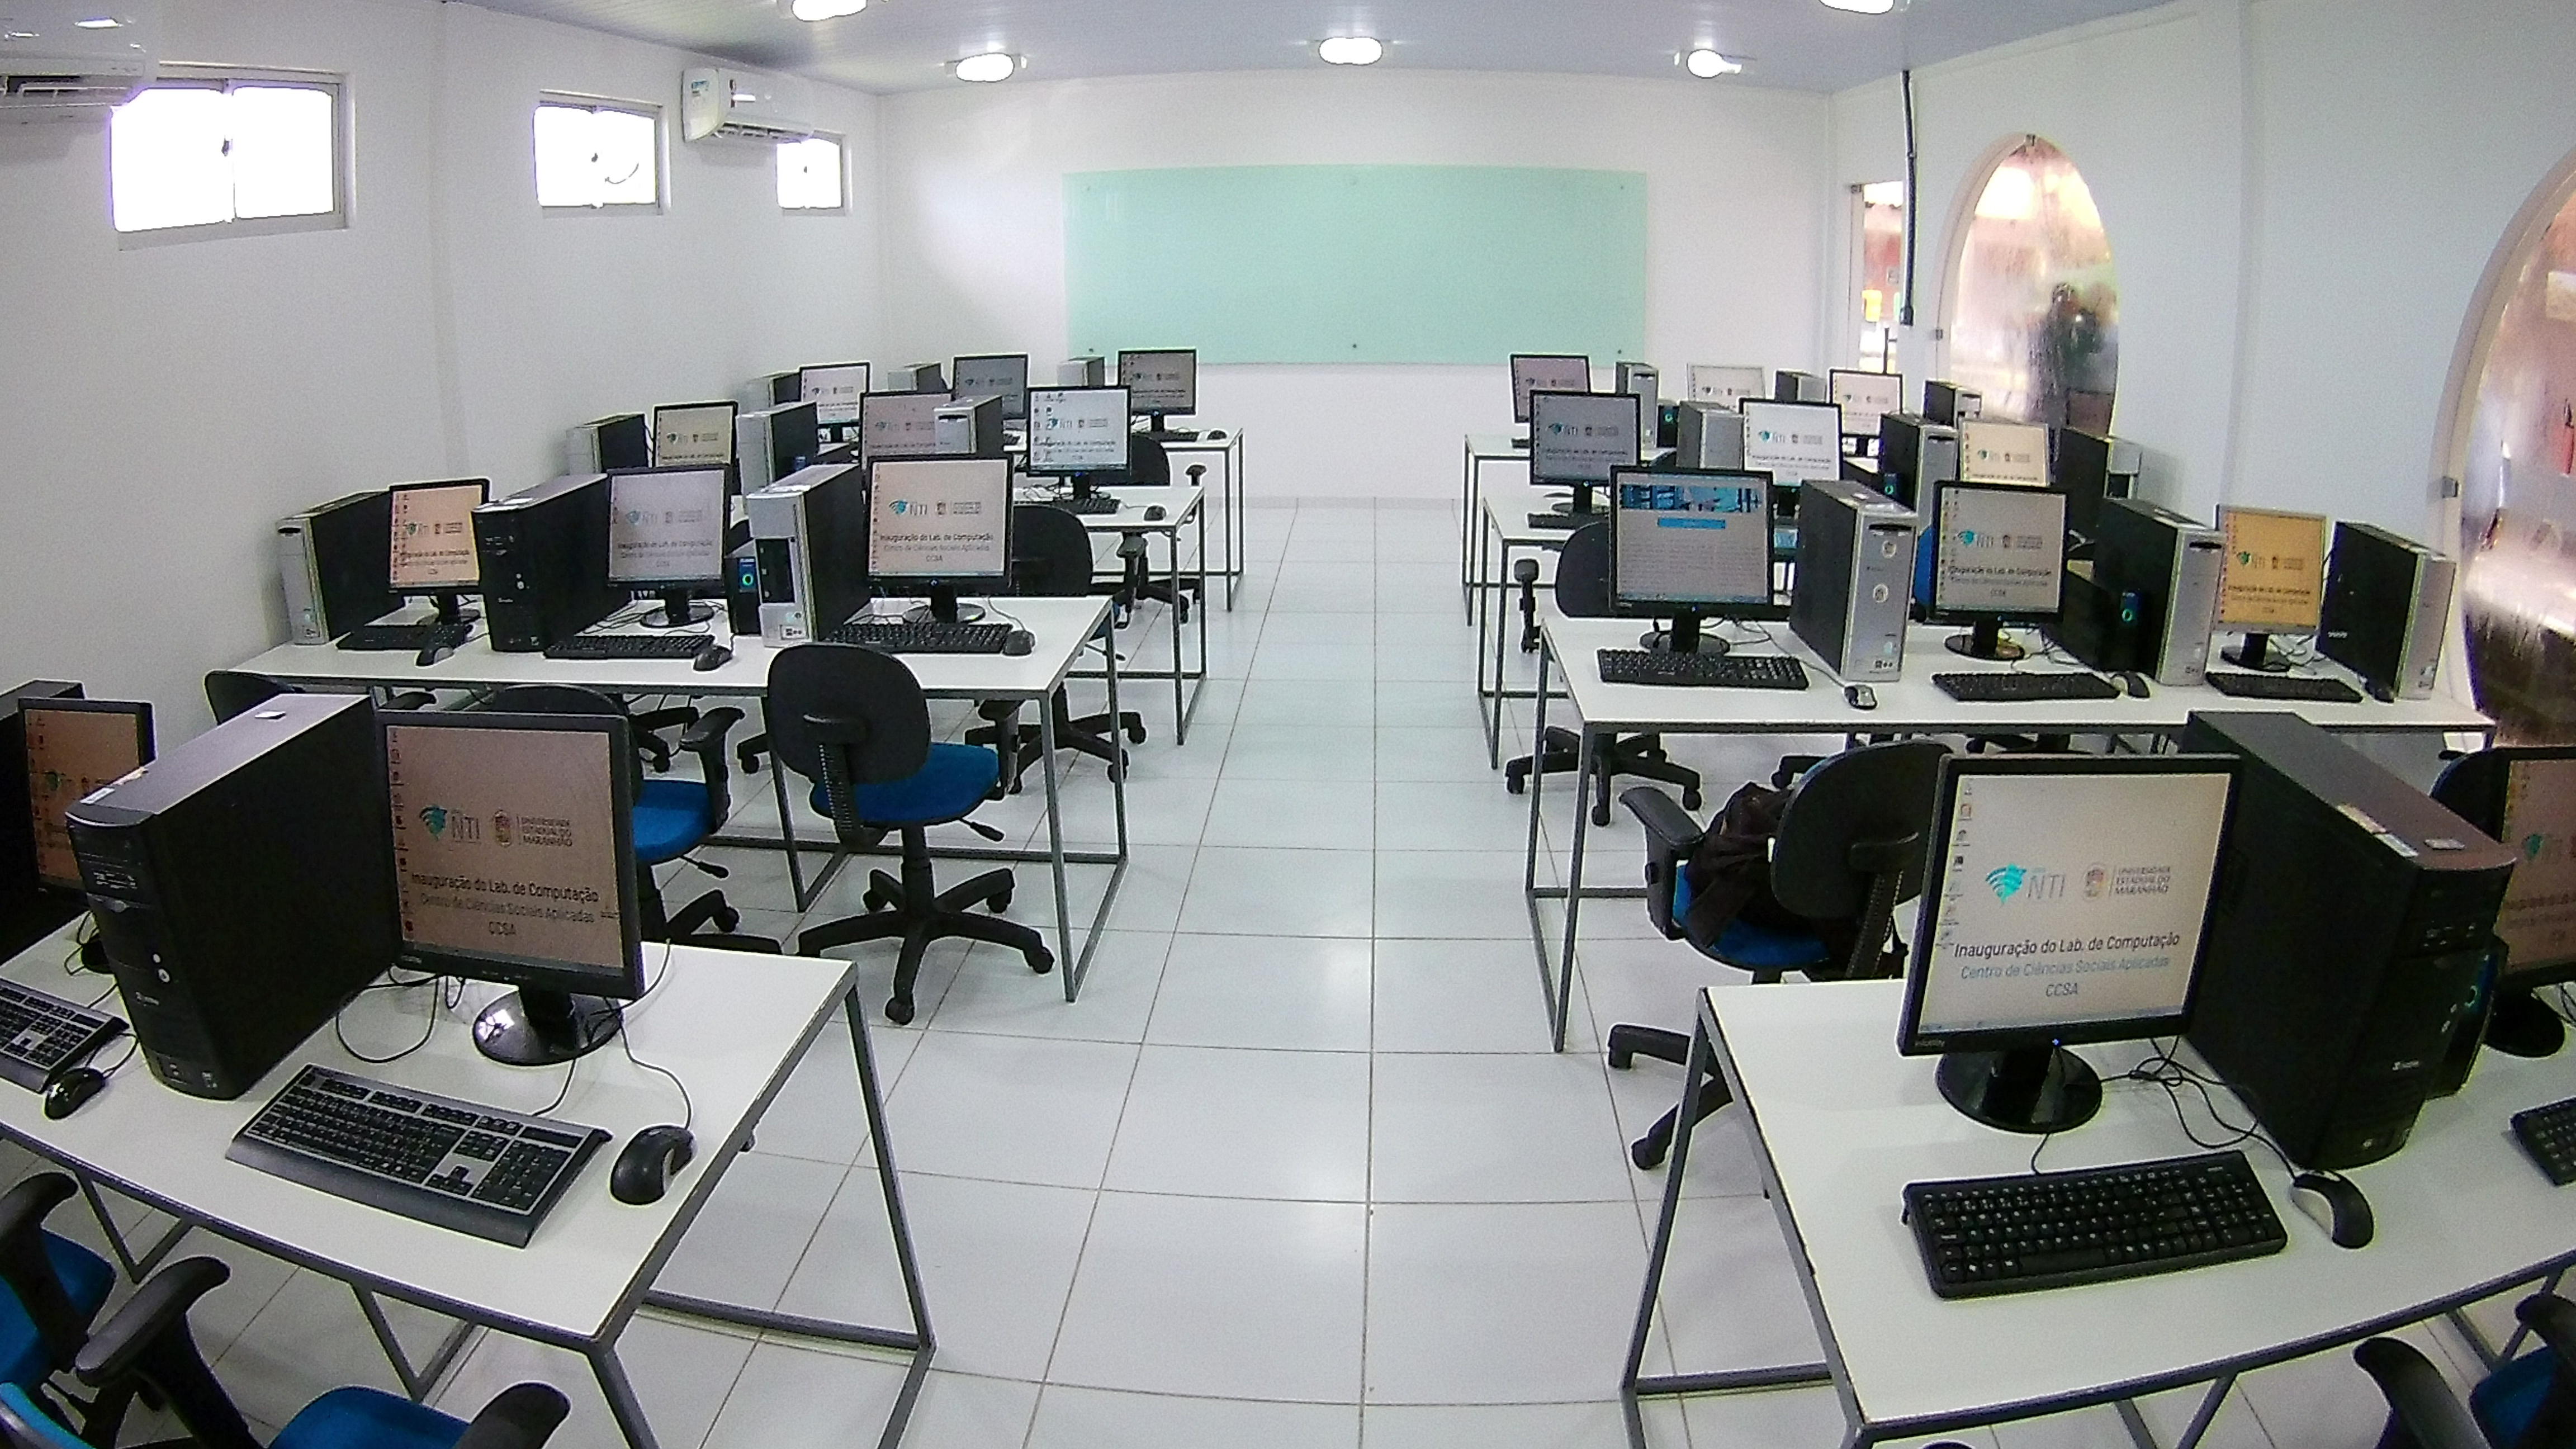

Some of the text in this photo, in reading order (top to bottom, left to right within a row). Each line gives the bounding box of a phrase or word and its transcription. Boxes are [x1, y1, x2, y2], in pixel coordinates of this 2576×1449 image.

[451, 816, 480, 840] NTI
[411, 874, 599, 904] Inauguração do Lab. de Computação
[2026, 874, 2065, 899] NTI
[421, 893, 449, 907] Centro
[453, 896, 463, 908] de
[546, 908, 594, 922] Aplicadas
[489, 921, 516, 935] CCSA
[1954, 932, 2180, 960] Inauguração do Lab. de Computação
[1961, 955, 2169, 979] Centro de Ciências Sociais Aplicadas
[2045, 982, 2078, 997] CCSA
